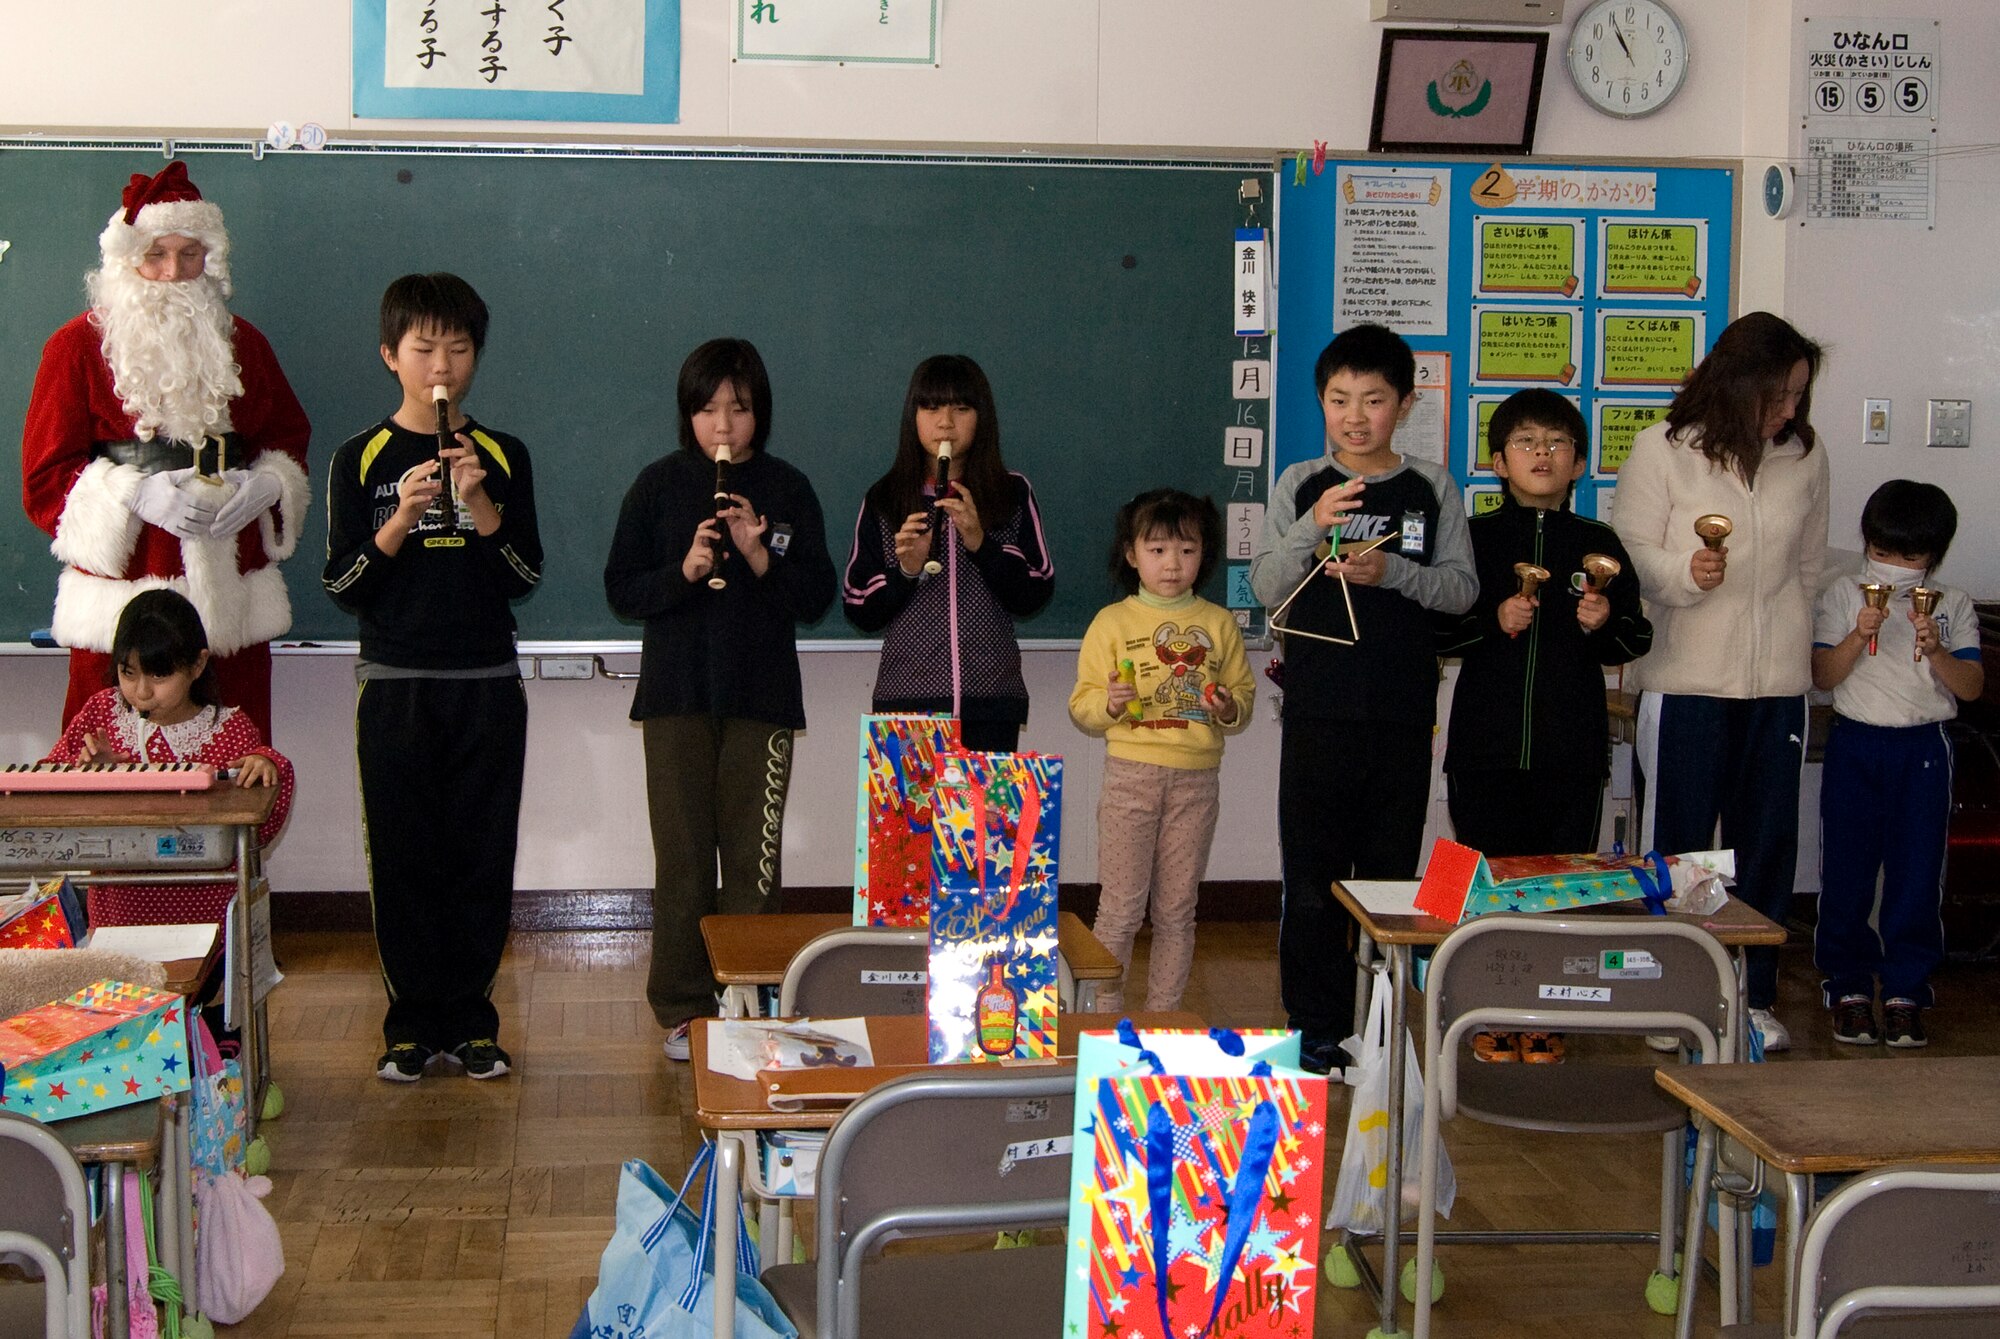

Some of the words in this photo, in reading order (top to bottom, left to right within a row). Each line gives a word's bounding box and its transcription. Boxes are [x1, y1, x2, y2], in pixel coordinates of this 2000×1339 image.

[1608, 10, 1616, 28] 11
[1625, 6, 1635, 25] 12
[1646, 13, 1650, 30] 1
[416, 0, 447, 70] る子
[1593, 23, 1603, 41] 10
[1656, 25, 1665, 44] 2
[1833, 31, 1909, 51] ひなん口
[1585, 44, 1593, 62] 9
[1664, 48, 1672, 66] 3
[1894, 55, 1932, 69] じしん
[1592, 65, 1600, 83] 8
[1656, 69, 1664, 87] 4
[1606, 80, 1614, 98] 7
[1623, 86, 1631, 104] 6
[1641, 82, 1649, 100] 5
[1821, 86, 1839, 107] 15
[1864, 87, 1878, 108] 5
[1903, 82, 1919, 107] 5
[1848, 141, 1914, 152] ひなん口の場所
[1479, 170, 1501, 198] 2
[1492, 227, 1550, 240] さいばい係
[1627, 228, 1673, 241] ほけん係
[1242, 246, 1257, 275] 金川
[1501, 315, 1558, 328] はいたつ係
[1626, 320, 1681, 333] こくばん係
[1239, 366, 1260, 393] 月
[1418, 366, 1429, 380] う
[1235, 403, 1258, 426] 16
[1611, 409, 1656, 421] フッ素係
[1232, 437, 1253, 460] 日
[1238, 506, 1252, 556] よう日
[1328, 513, 1391, 541] NIKE
[1236, 569, 1253, 606] 天気
[1608, 955, 1618, 967] 4
